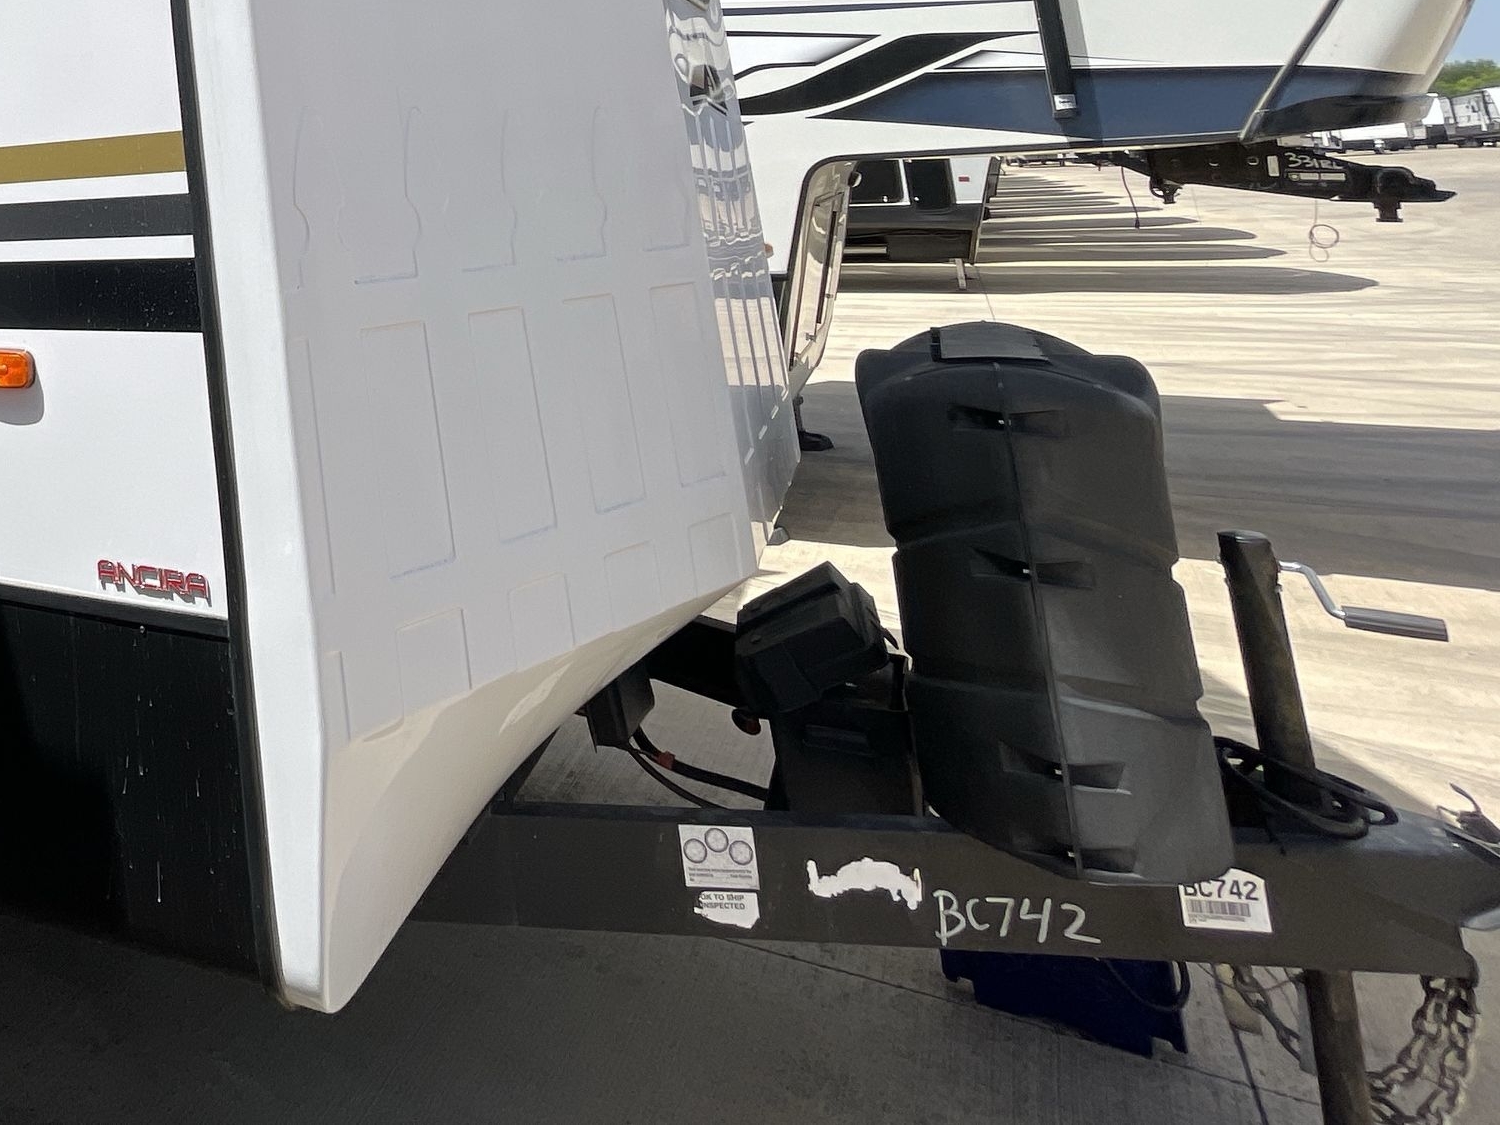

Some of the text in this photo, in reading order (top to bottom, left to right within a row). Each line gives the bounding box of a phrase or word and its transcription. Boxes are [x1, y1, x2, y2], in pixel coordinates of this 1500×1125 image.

[97, 559, 209, 600] ANCIRA
[713, 893, 725, 901] TO
[1183, 879, 1259, 901] BC742
[932, 889, 1102, 947] BC742
